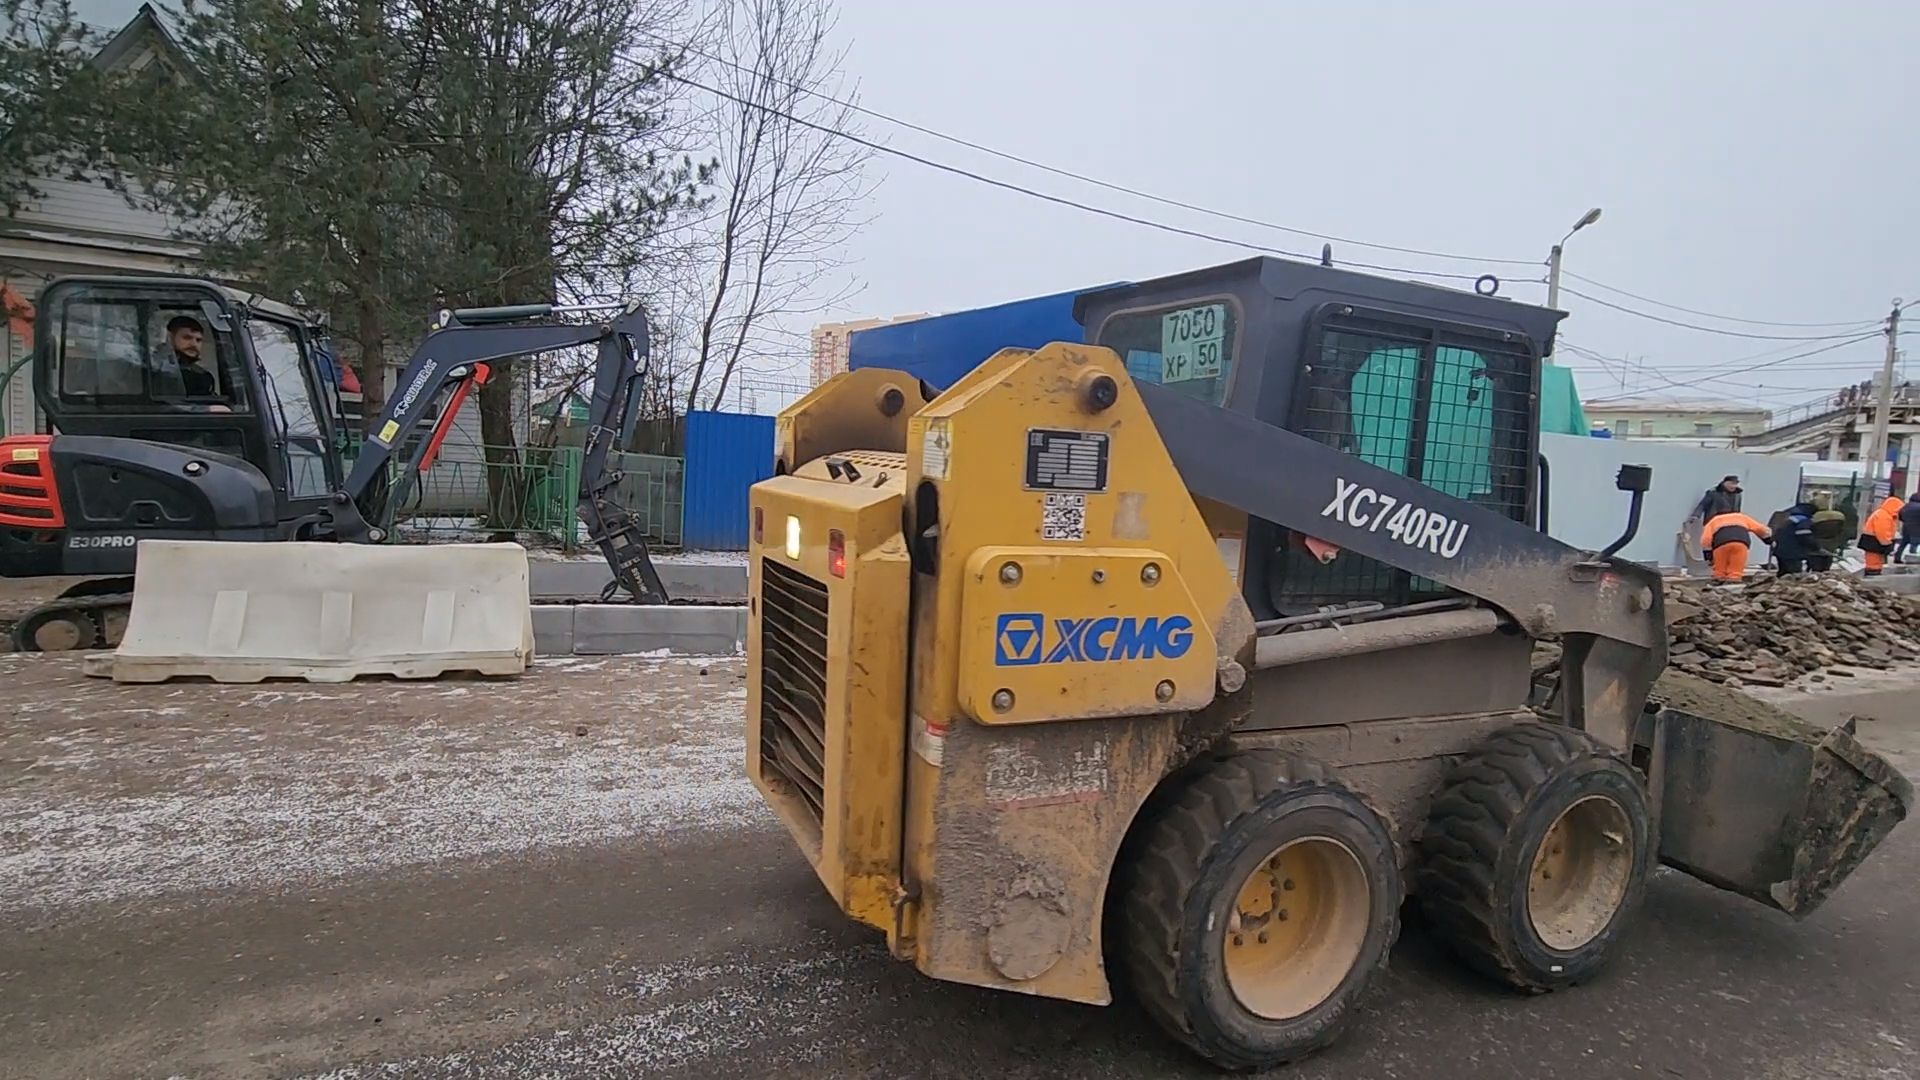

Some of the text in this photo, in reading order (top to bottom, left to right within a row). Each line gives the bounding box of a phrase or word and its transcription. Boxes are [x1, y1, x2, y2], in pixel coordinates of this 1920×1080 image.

[1169, 307, 1215, 344] 7050
[1198, 342, 1217, 366] 50
[1320, 477, 1470, 559] XC740RU
[68, 535, 136, 549] E30PRO
[1041, 615, 1194, 663] XCMG
